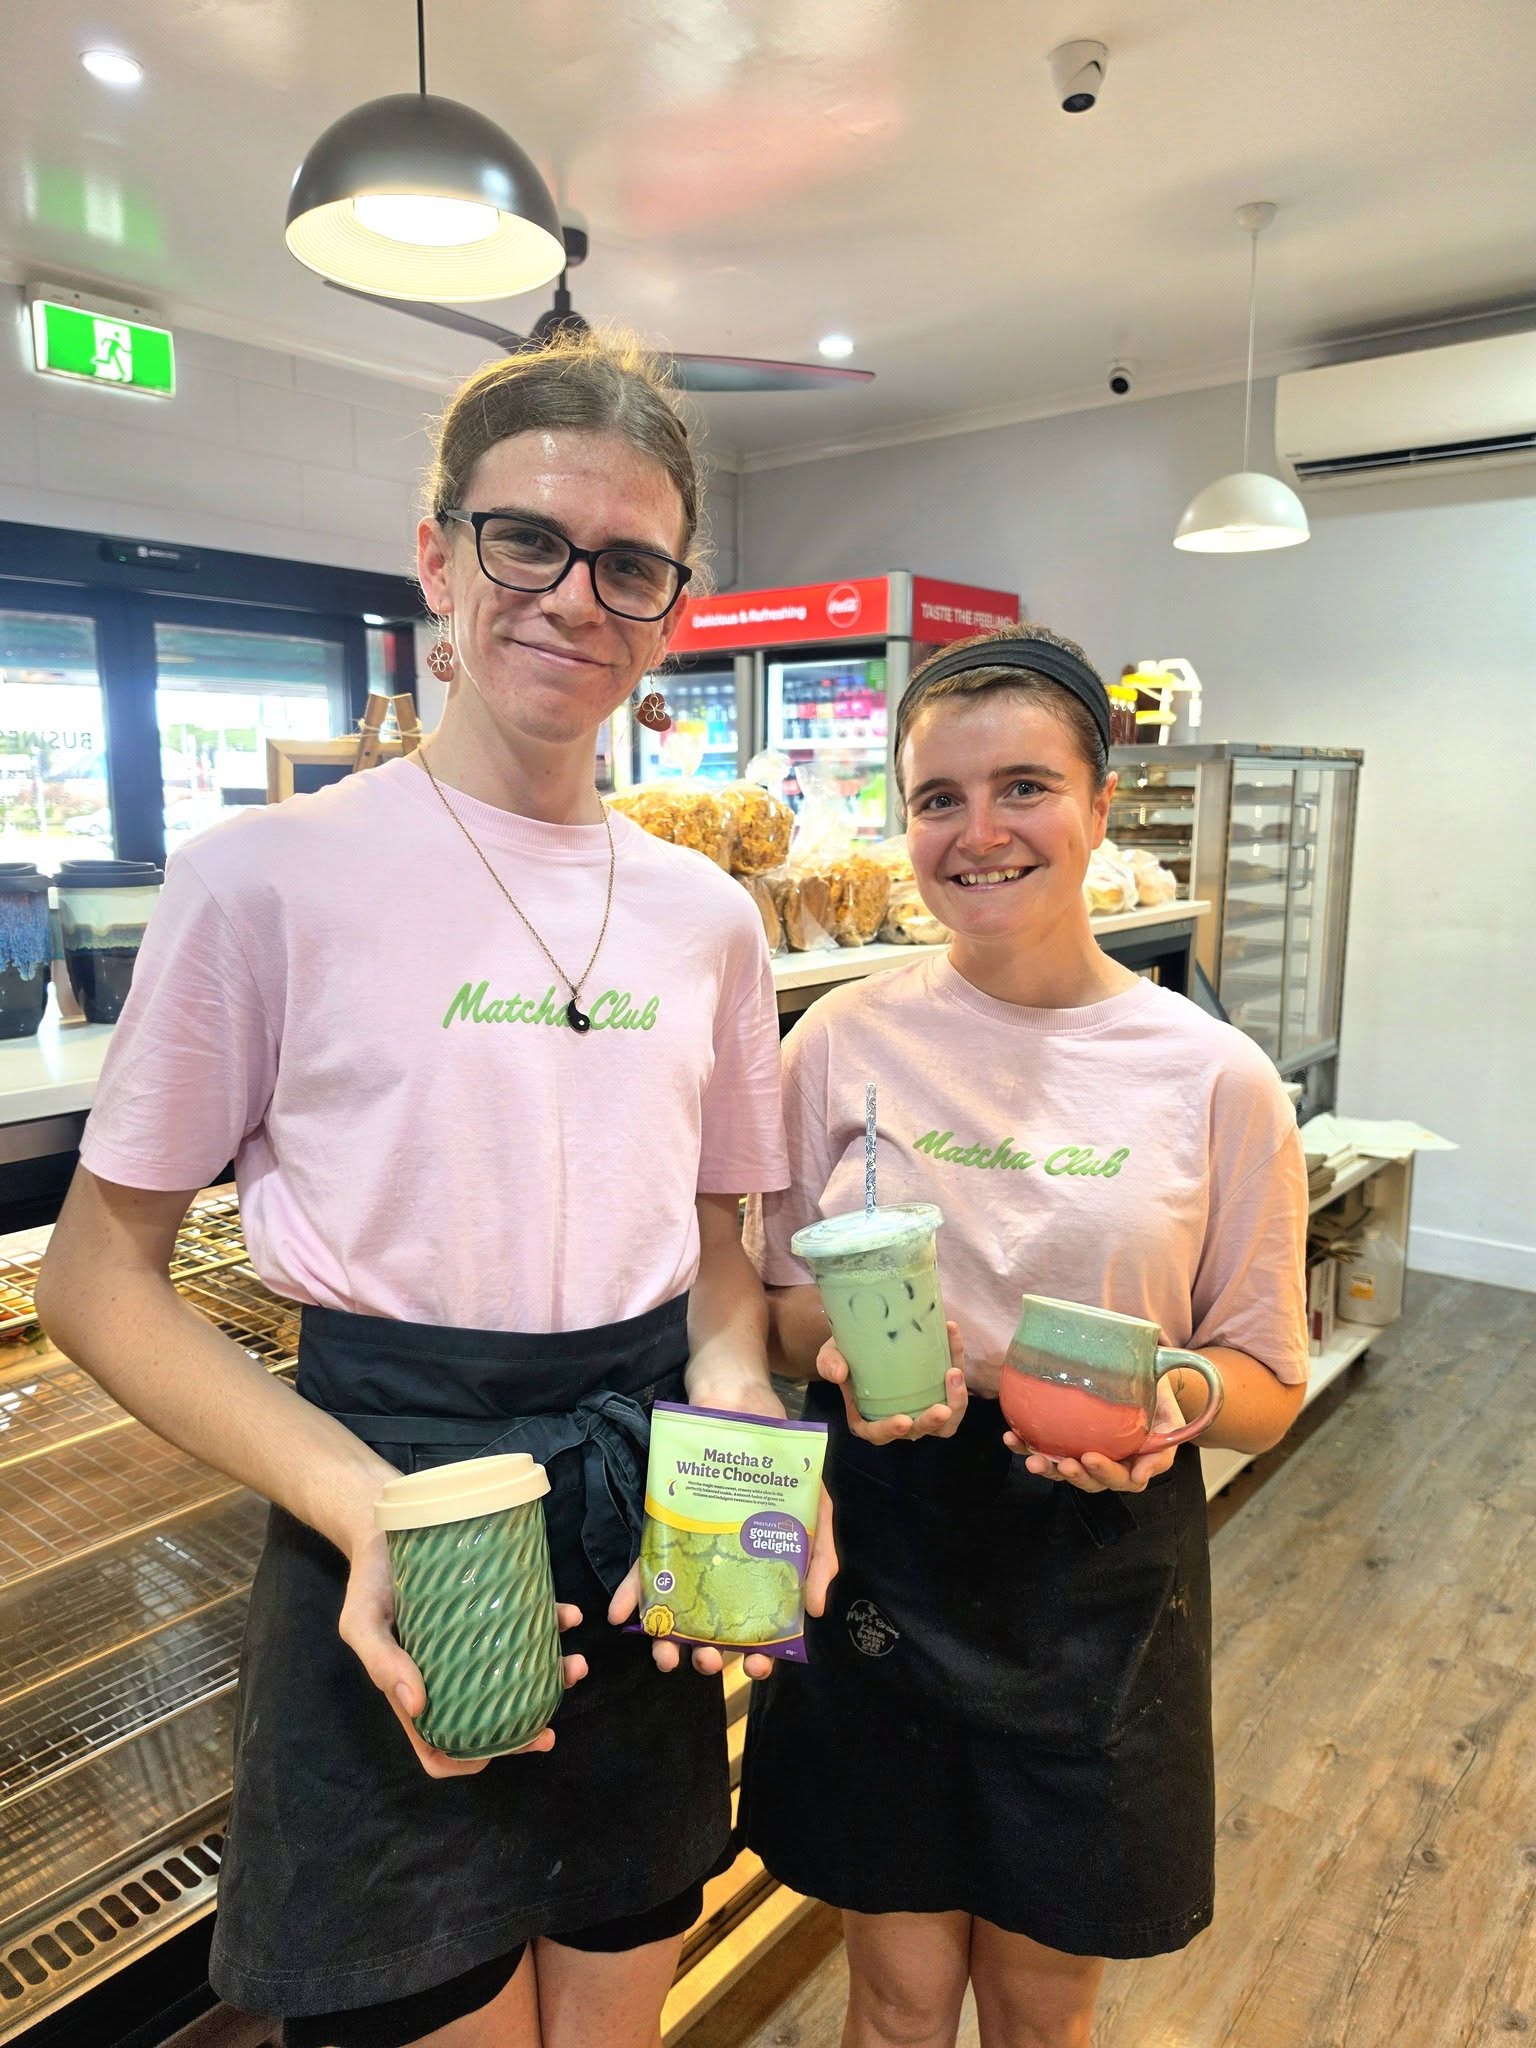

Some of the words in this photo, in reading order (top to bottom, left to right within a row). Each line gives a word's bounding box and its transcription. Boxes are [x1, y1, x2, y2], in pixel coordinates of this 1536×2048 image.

[921, 602, 953, 622] TASTE
[954, 608, 973, 625] THE
[442, 980, 570, 1029] Matcha
[588, 989, 660, 1030] Club
[912, 1129, 1036, 1170] Matcha
[1044, 1145, 1130, 1178] Club
[703, 1448, 759, 1468] Matcha
[762, 1456, 774, 1469] &
[676, 1460, 721, 1479] White
[723, 1466, 799, 1488] Chocolate
[749, 1527, 799, 1542] gourmet
[753, 1538, 802, 1554] delights
[657, 1577, 672, 1586] GF
